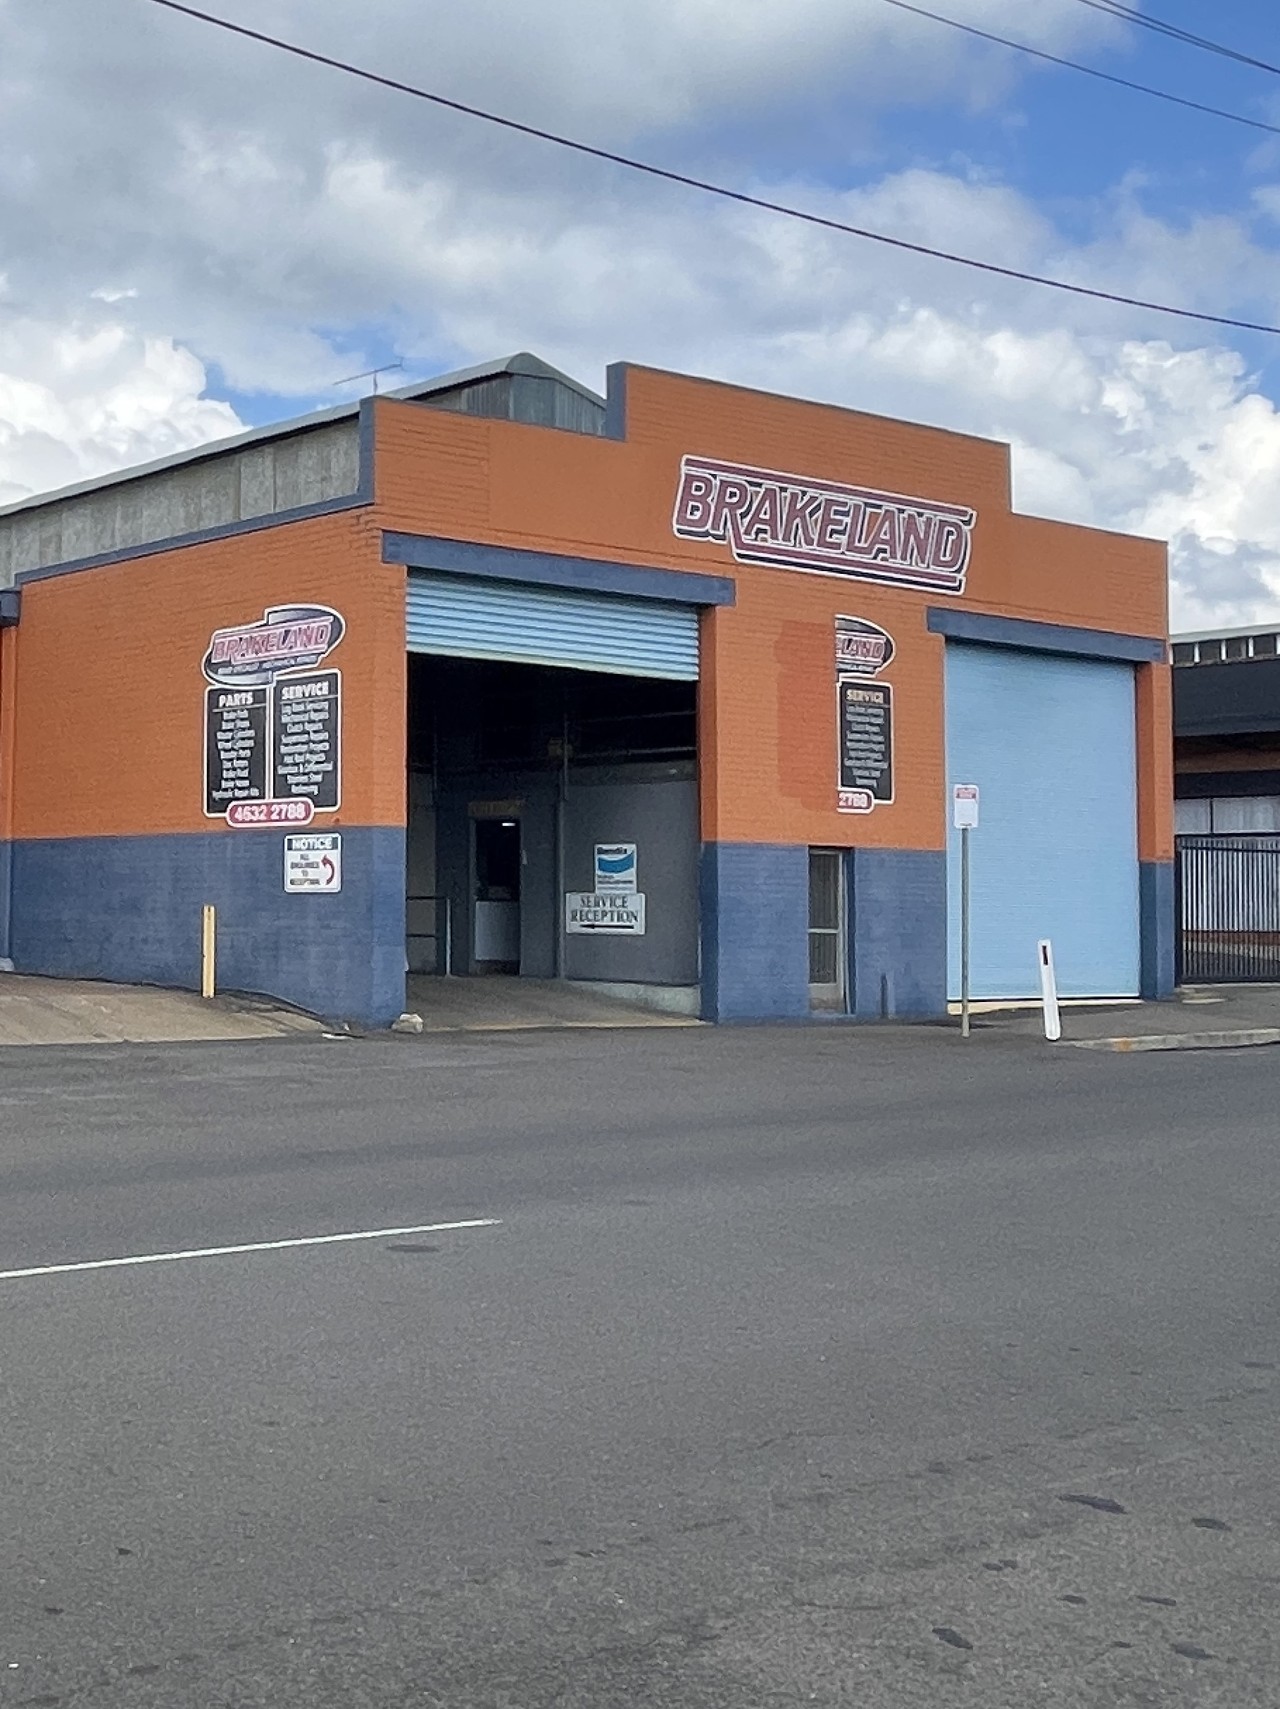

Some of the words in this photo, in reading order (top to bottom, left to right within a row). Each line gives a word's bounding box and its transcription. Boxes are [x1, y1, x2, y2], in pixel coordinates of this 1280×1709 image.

[675, 468, 966, 574] BRAKELAND
[281, 681, 329, 700] SERVICE
[219, 692, 253, 707] PARTS
[292, 838, 332, 850] NOTICE
[580, 895, 629, 909] SERVICE
[570, 910, 639, 923] RECEPTION
